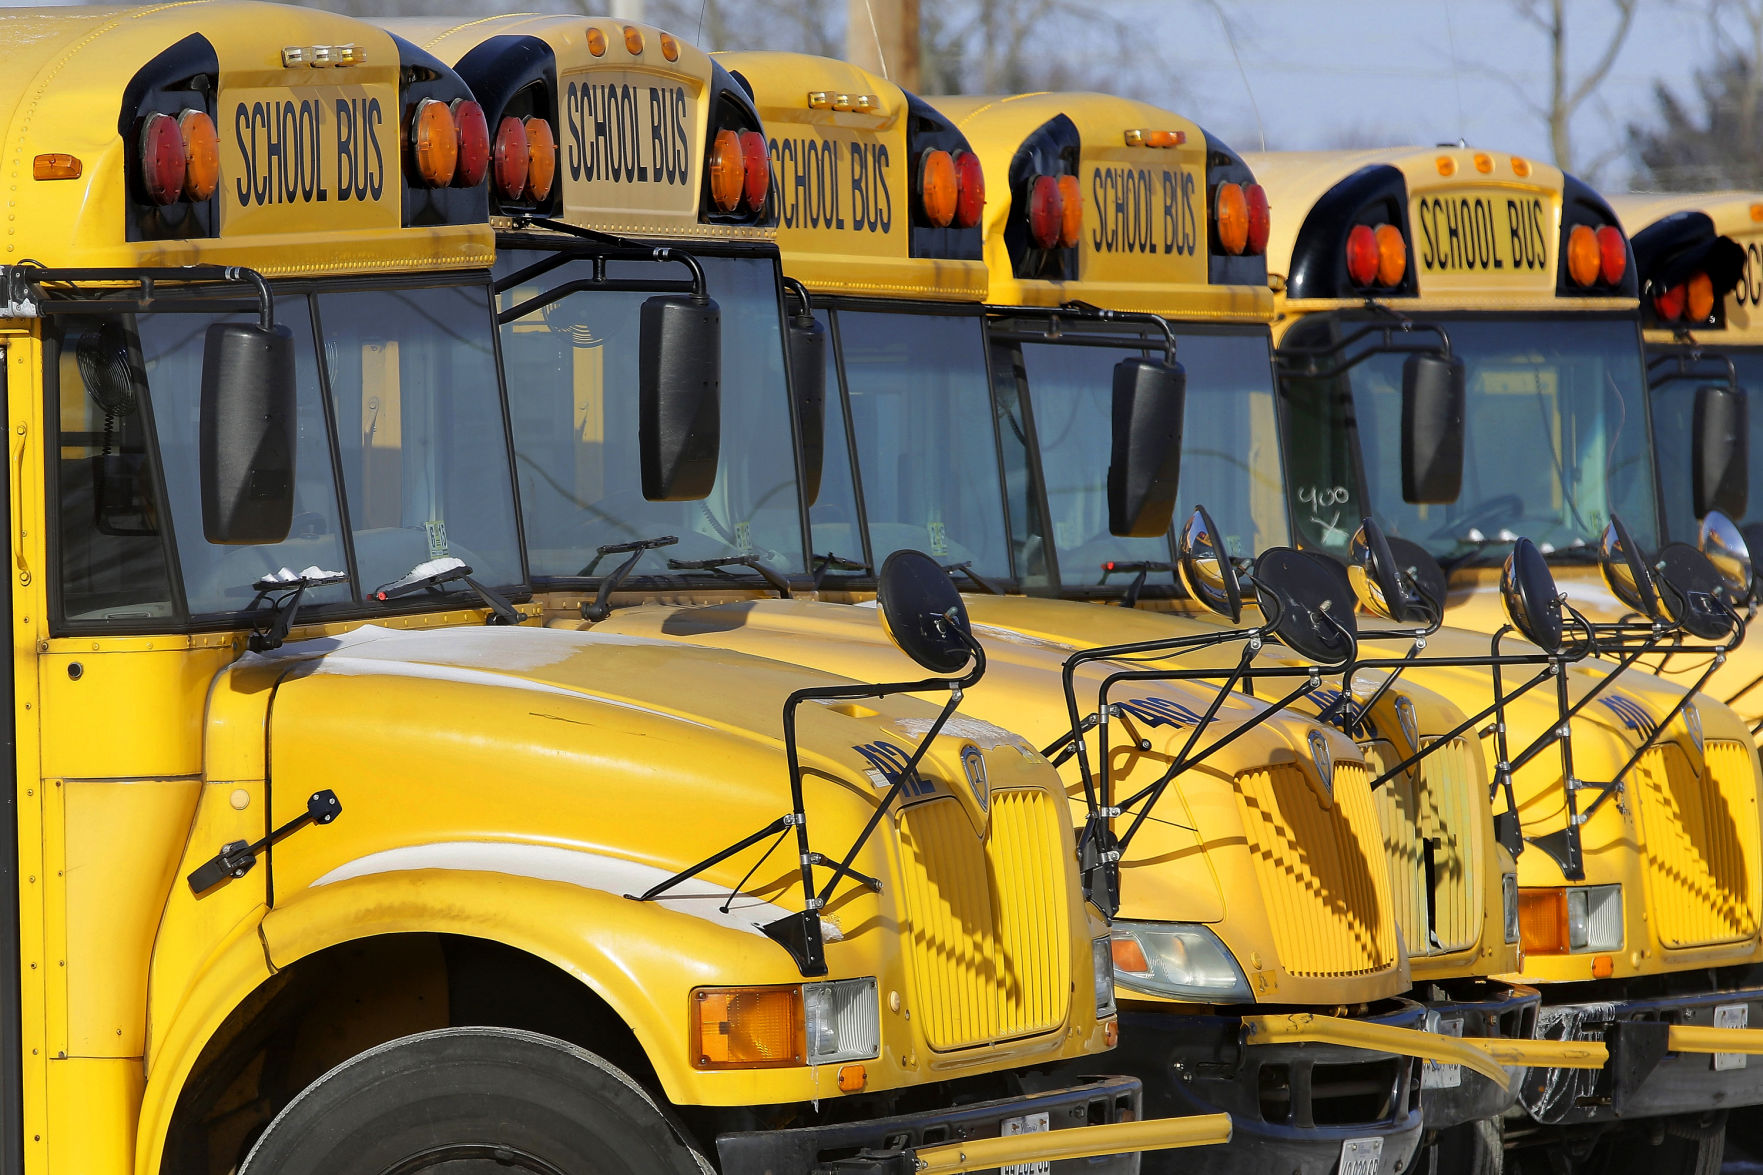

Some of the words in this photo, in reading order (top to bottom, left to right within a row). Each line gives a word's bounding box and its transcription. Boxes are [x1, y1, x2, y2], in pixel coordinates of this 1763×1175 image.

[235, 98, 328, 207] SCHOOL
[337, 97, 384, 203] BUS
[568, 81, 647, 184] SCHOOL
[650, 86, 689, 186] BUS
[851, 141, 892, 234] BUS
[1093, 167, 1157, 254] SCHOOL
[1163, 170, 1197, 257] BUS
[1420, 197, 1503, 270] SCHOOL
[1507, 199, 1546, 271] BUS
